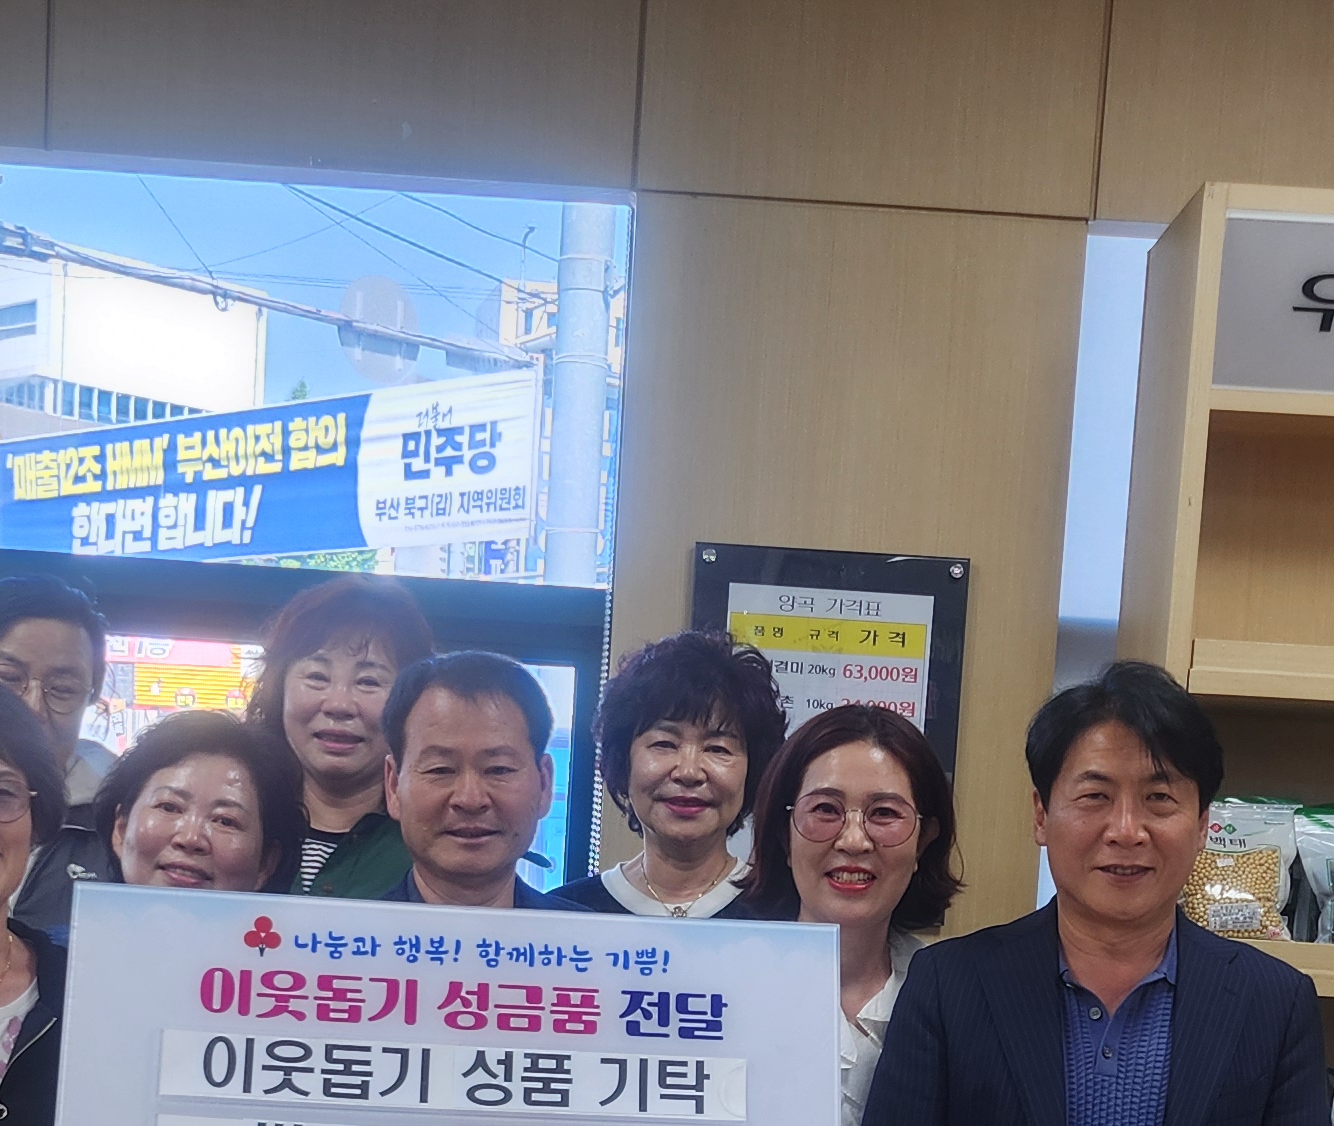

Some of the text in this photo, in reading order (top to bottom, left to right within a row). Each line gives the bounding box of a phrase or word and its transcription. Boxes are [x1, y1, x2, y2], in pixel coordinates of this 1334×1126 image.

[415, 401, 453, 430] 더불어
[176, 428, 284, 482] 부산이전
[289, 413, 347, 469] 합의
[401, 420, 503, 482] 민주당
[72, 484, 263, 554] 한다면 합니다!
[375, 485, 527, 522] 부산 북구(갑) 지역위원회
[778, 594, 882, 618] 양곡 가격표
[859, 629, 907, 649] 가격
[767, 660, 919, 684] 결미 20kg 63,000원
[806, 698, 834, 711] 10kg
[292, 931, 672, 974] 나눔과 행복! 함께하는 기쁨!
[199, 967, 728, 1040] 이웃돕기 성금품 전달
[203, 1035, 710, 1116] 이웃돕기 성품 기탁
